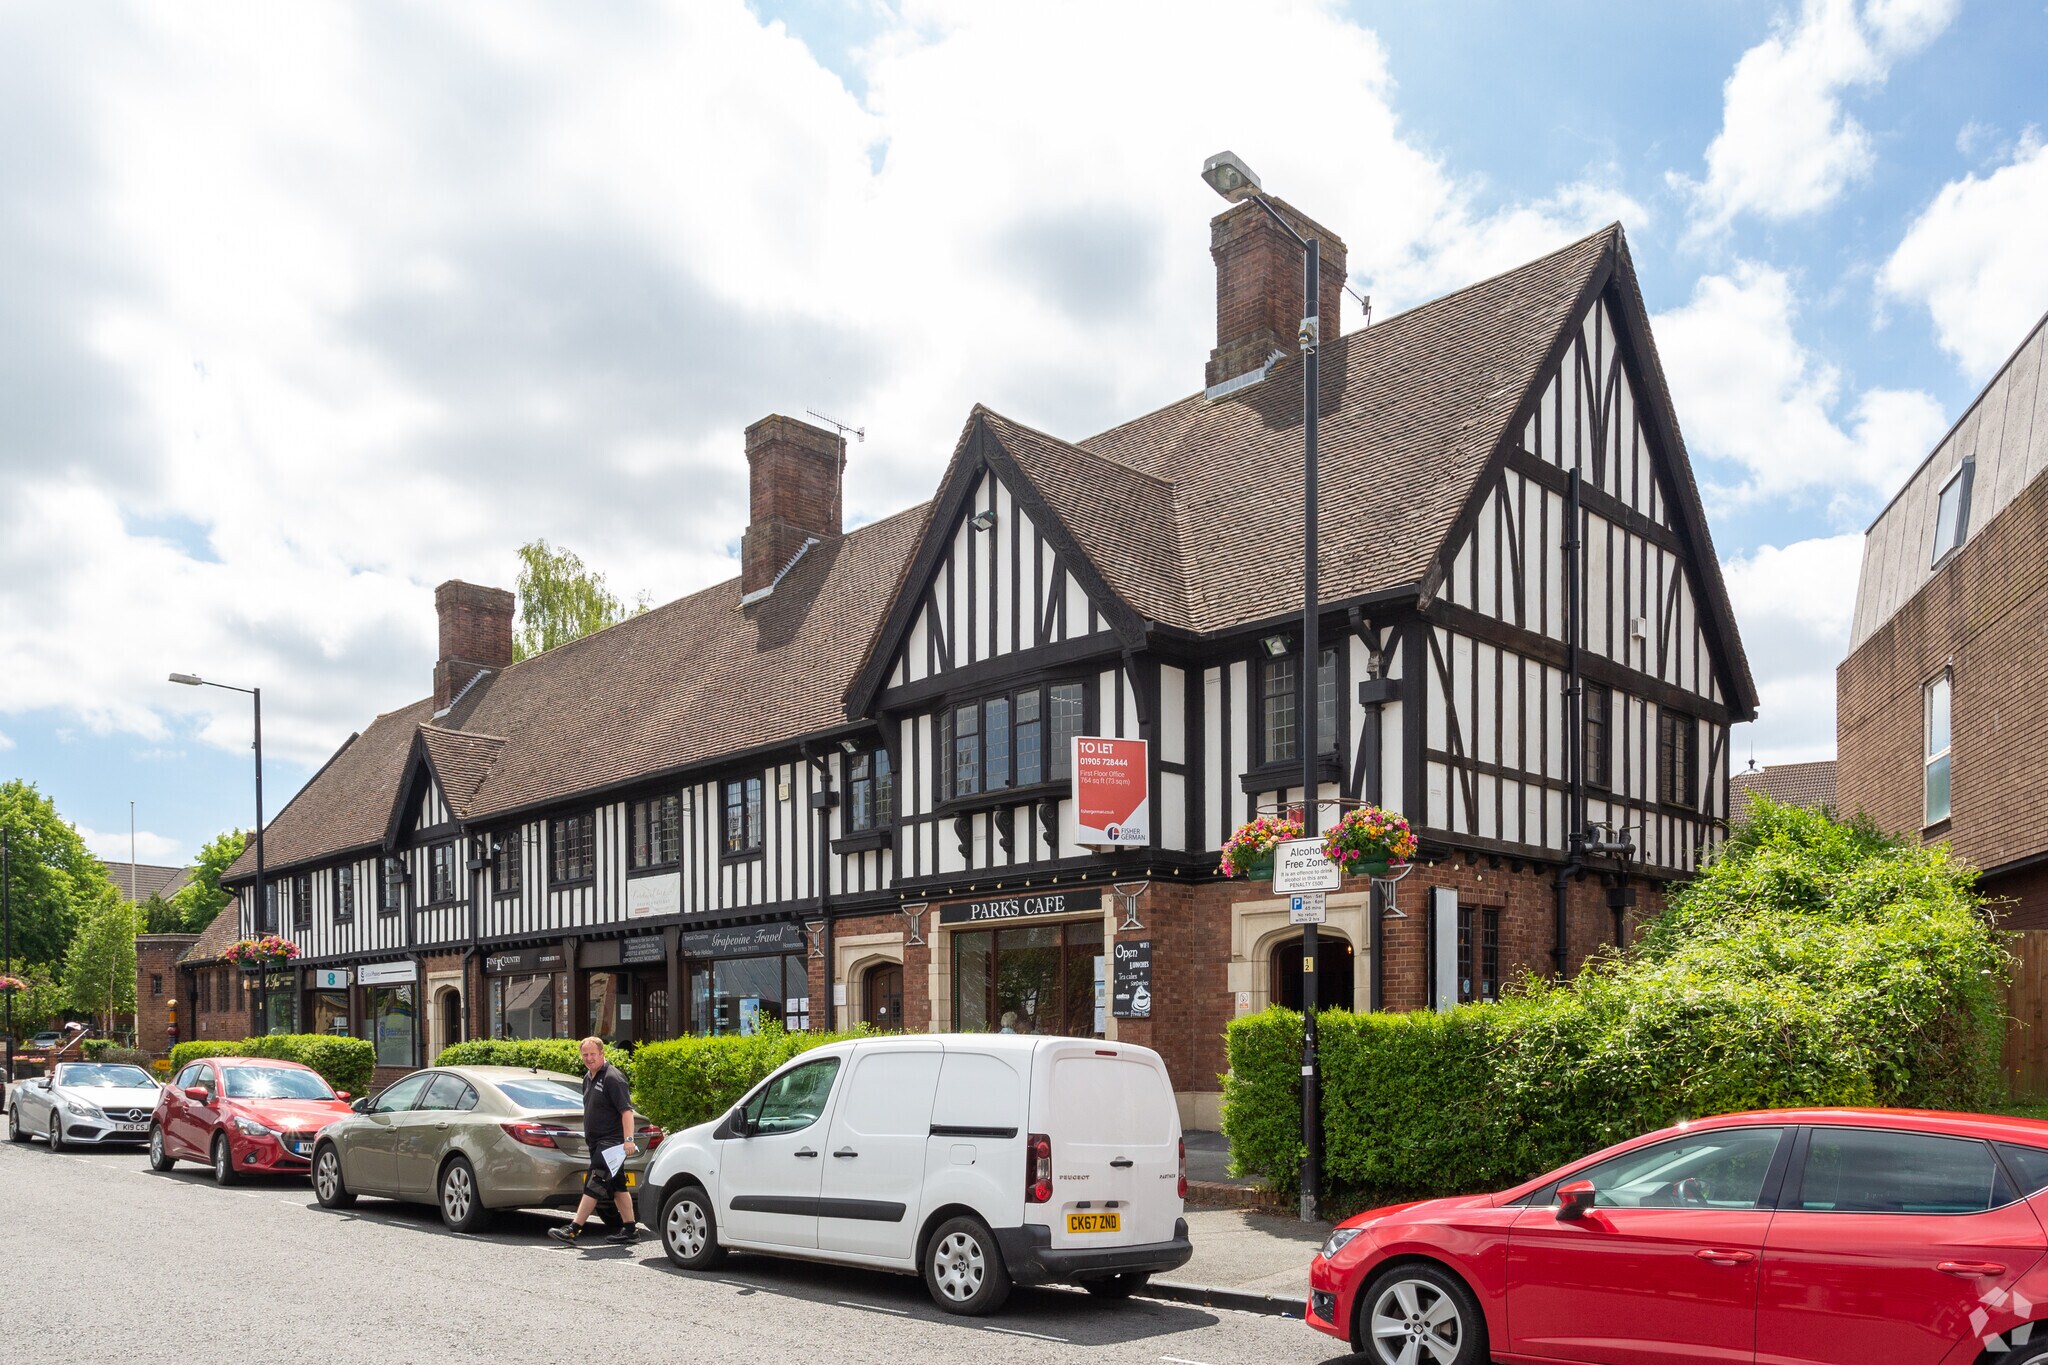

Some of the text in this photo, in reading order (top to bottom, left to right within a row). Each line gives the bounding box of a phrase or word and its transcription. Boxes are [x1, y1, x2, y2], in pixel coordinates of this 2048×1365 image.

[1080, 742, 1113, 754] TO LET
[1102, 758, 1128, 767] 728444
[1285, 858, 1328, 869] Free Zone
[970, 896, 1065, 919] PARK'S CAFE
[711, 927, 784, 951] Grapevine Travel
[1115, 944, 1138, 961] Open
[500, 956, 520, 966] COUNTRY
[1071, 1215, 1117, 1230] CK67 ZND
